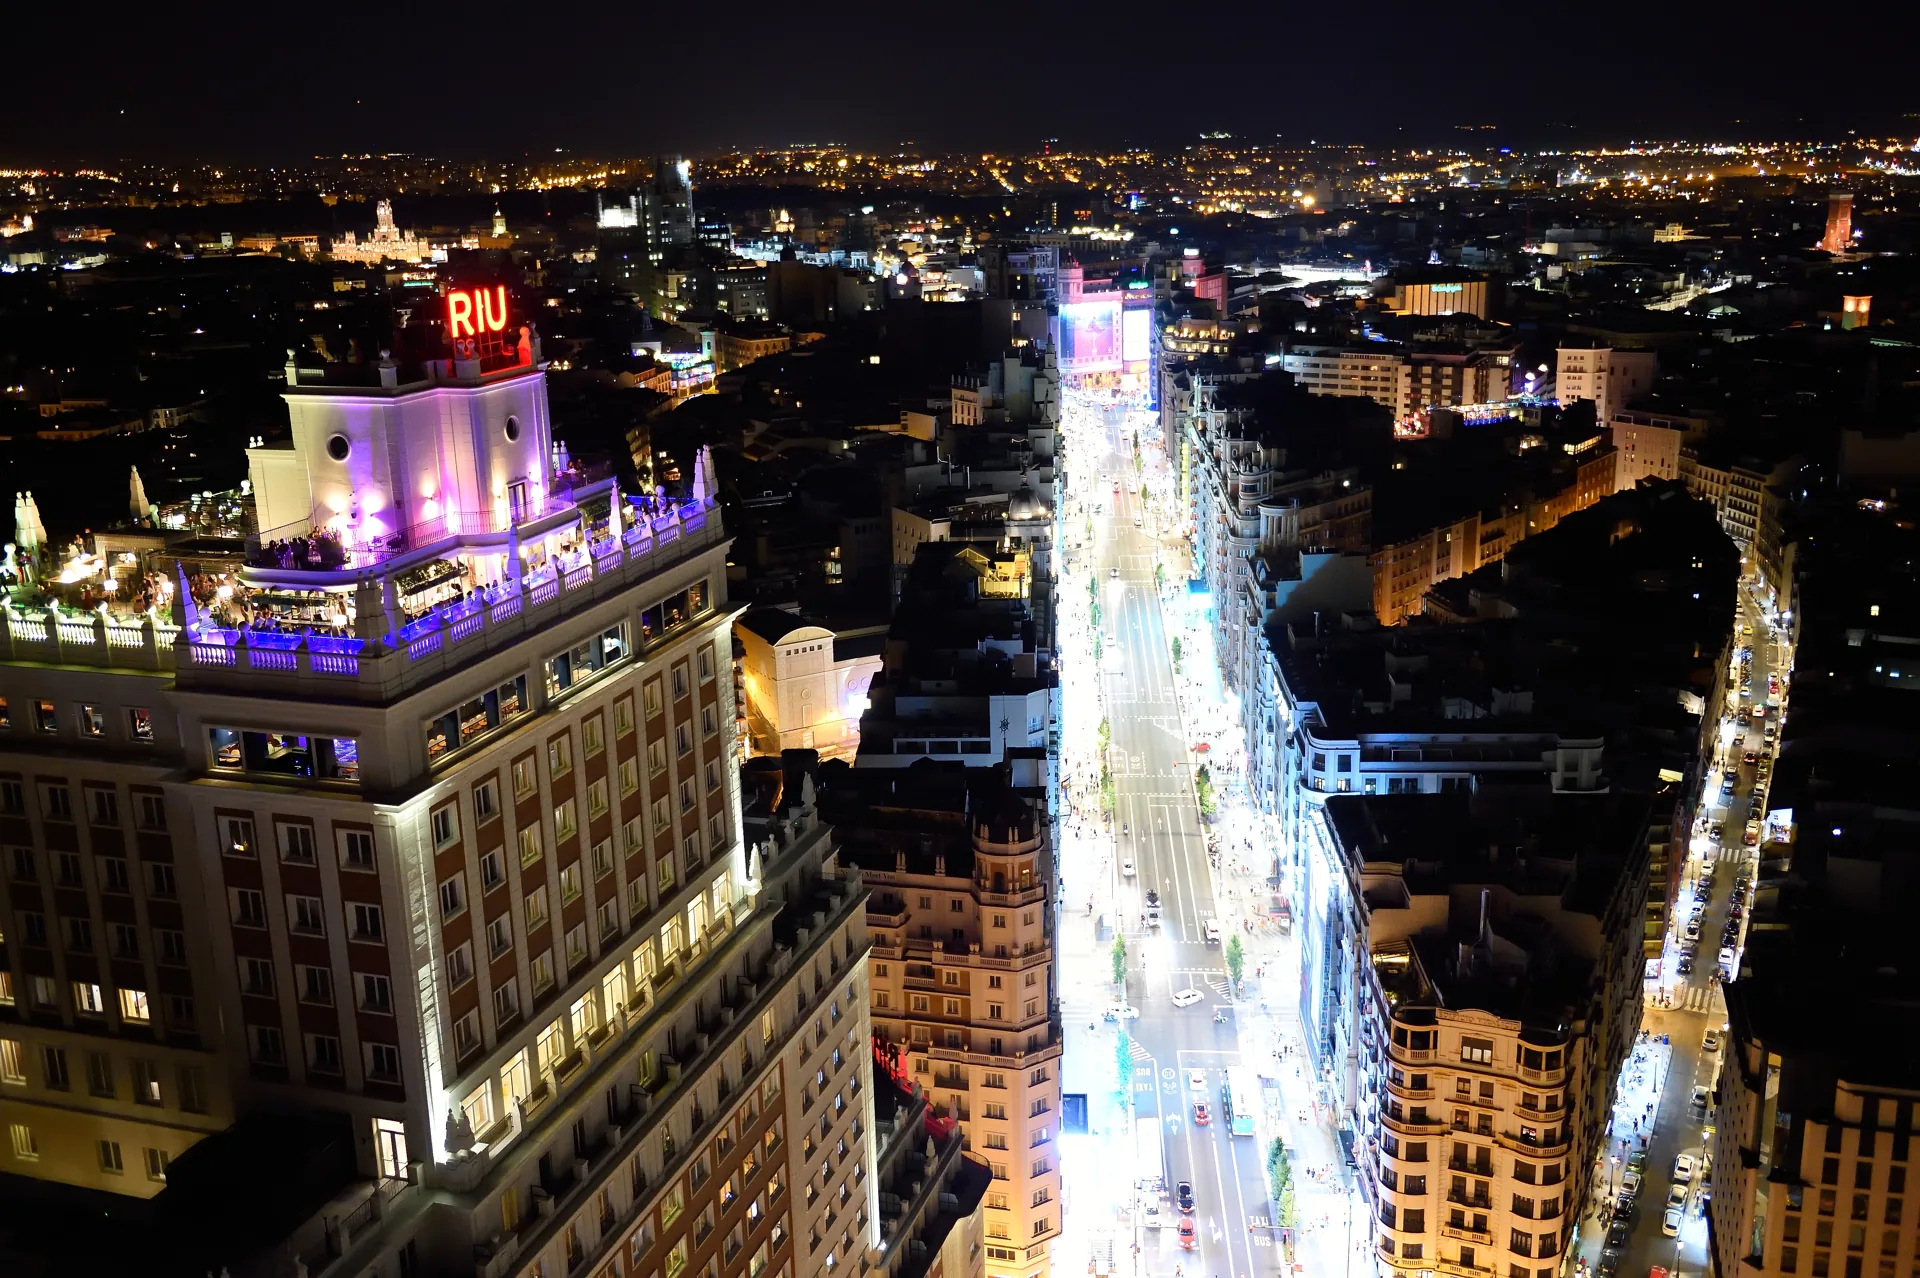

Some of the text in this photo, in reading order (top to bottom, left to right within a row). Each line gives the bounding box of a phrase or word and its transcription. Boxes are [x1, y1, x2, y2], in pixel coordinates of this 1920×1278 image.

[447, 284, 507, 338] RIU
[1199, 909, 1214, 917] TAXI
[1135, 1067, 1151, 1077] BUS
[1135, 1082, 1154, 1092] TAXI
[1248, 1215, 1269, 1226] TAXI
[1253, 1235, 1272, 1247] BUS
